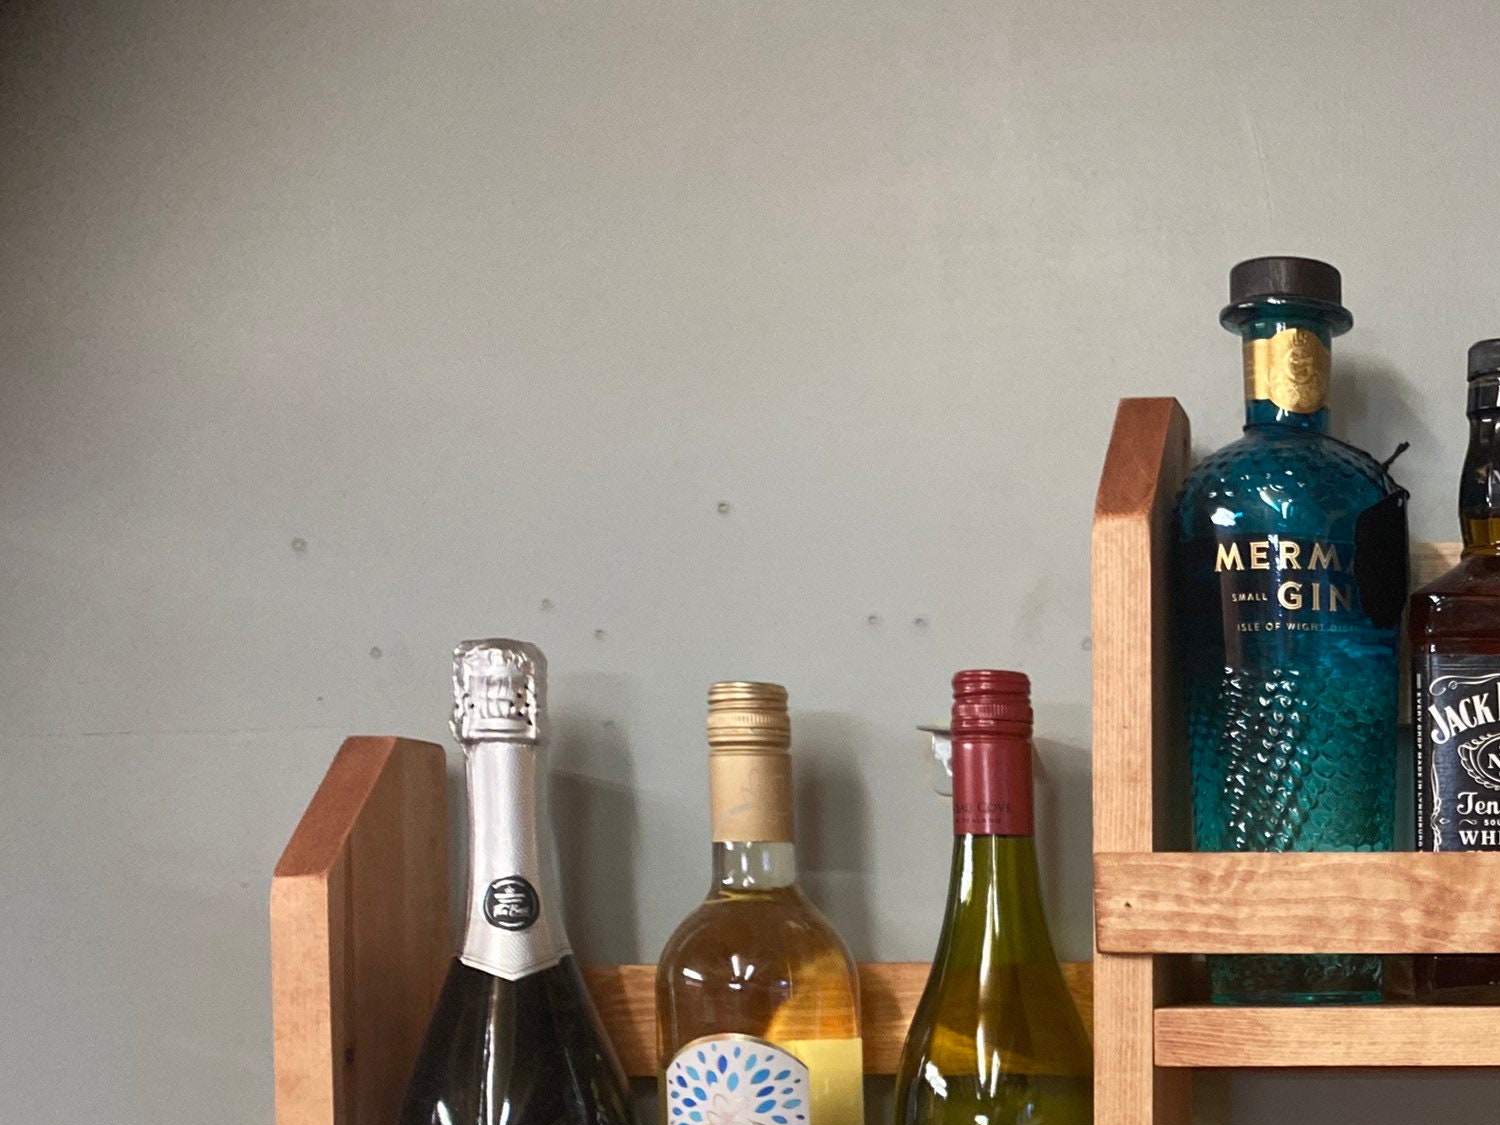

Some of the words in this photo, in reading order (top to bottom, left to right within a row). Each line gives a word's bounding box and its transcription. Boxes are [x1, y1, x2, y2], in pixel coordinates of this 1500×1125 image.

[1214, 541, 1353, 573] MERM
[1232, 592, 1268, 602] SMALL
[1237, 622, 1260, 632] ISLE
[1265, 622, 1281, 632] OF
[1428, 692, 1497, 745] JACK
[1417, 780, 1423, 790] IN
